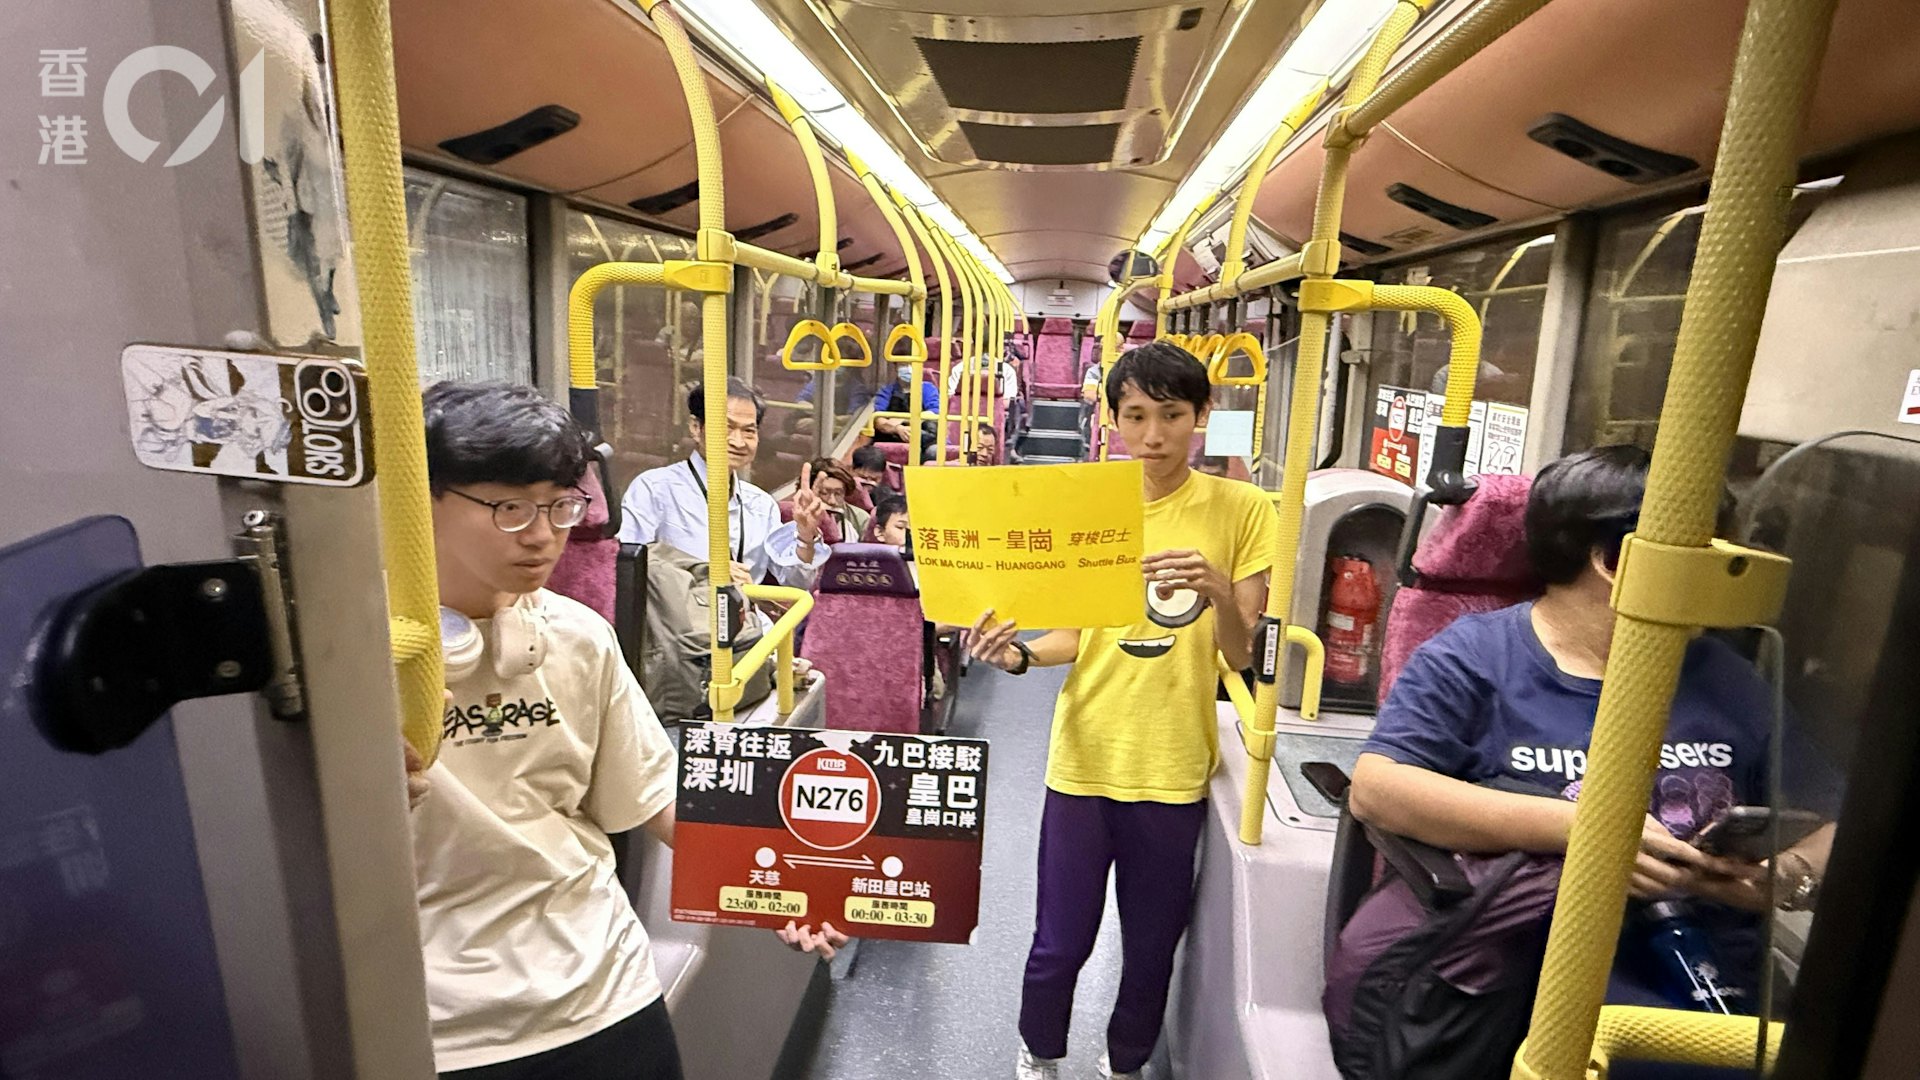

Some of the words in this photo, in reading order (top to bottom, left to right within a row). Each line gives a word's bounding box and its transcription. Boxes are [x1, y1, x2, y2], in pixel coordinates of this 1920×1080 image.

[918, 527, 980, 551] 落馬洲
[1006, 528, 1052, 553] 皇崗
[1067, 528, 1131, 546] 穿梭巴士
[918, 555, 938, 567] LOK
[940, 559, 954, 568] MA
[956, 560, 983, 570] CHAU
[996, 560, 1066, 571] HUANGGANG
[1078, 557, 1114, 568] Shuttle
[1116, 554, 1136, 565] Bus
[684, 726, 792, 760] 深宵往返
[872, 740, 982, 772] 九巴接駁
[682, 756, 755, 796] 深圳
[796, 784, 864, 813] N276
[906, 772, 978, 809] 皇巴
[904, 807, 977, 829] 皇崗口岸
[748, 869, 781, 887] 天慈
[851, 876, 932, 899] 新田皇巴站
[725, 897, 758, 911] 23:00
[768, 901, 801, 914] 02:00
[851, 908, 884, 922] 00:00
[894, 912, 928, 924] 03:30
